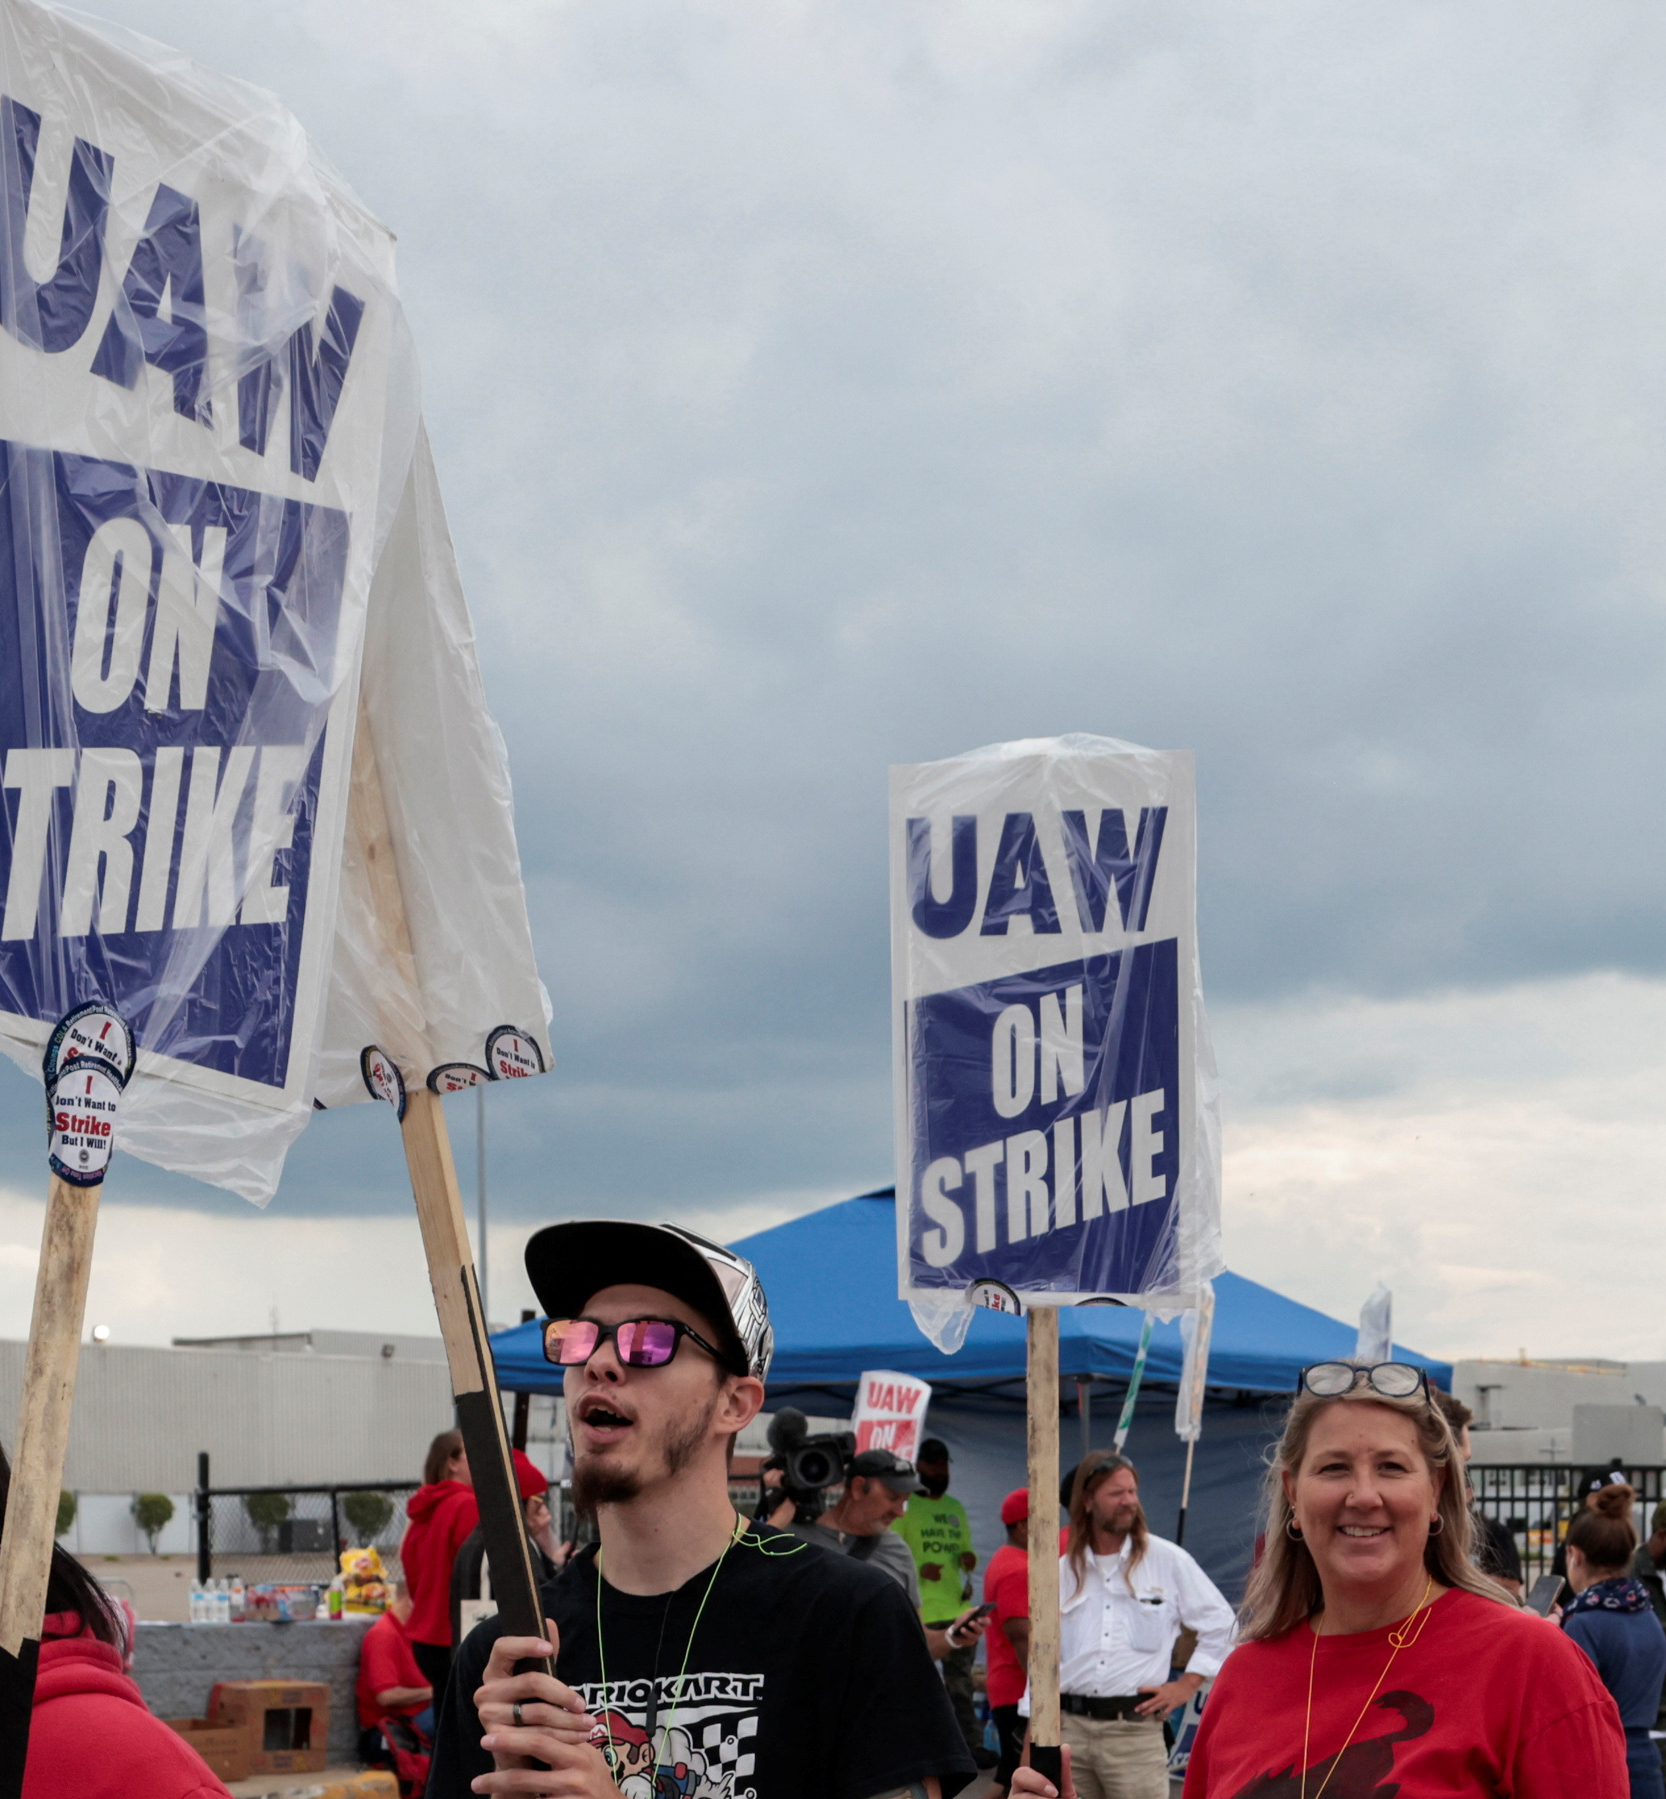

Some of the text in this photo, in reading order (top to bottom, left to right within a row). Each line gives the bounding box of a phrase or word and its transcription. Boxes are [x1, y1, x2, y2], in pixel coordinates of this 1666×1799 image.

[71, 517, 228, 713] ON
[906, 805, 1169, 940] UAW
[99, 1021, 112, 1040] I
[70, 1028, 93, 1048] Don't
[94, 1041, 118, 1062] Want
[496, 1047, 513, 1060] Don't
[514, 1039, 518, 1052] I
[992, 984, 1085, 1120] ON
[500, 1060, 532, 1078] Strik
[85, 1075, 93, 1094] I
[84, 1096, 105, 1111] Want
[108, 1101, 116, 1112] to
[55, 1111, 111, 1137] Strike
[61, 1134, 106, 1150] But I Will!
[921, 1087, 1166, 1270] STRIKE
[868, 1381, 922, 1415] UAW
[870, 1422, 897, 1451] ON
